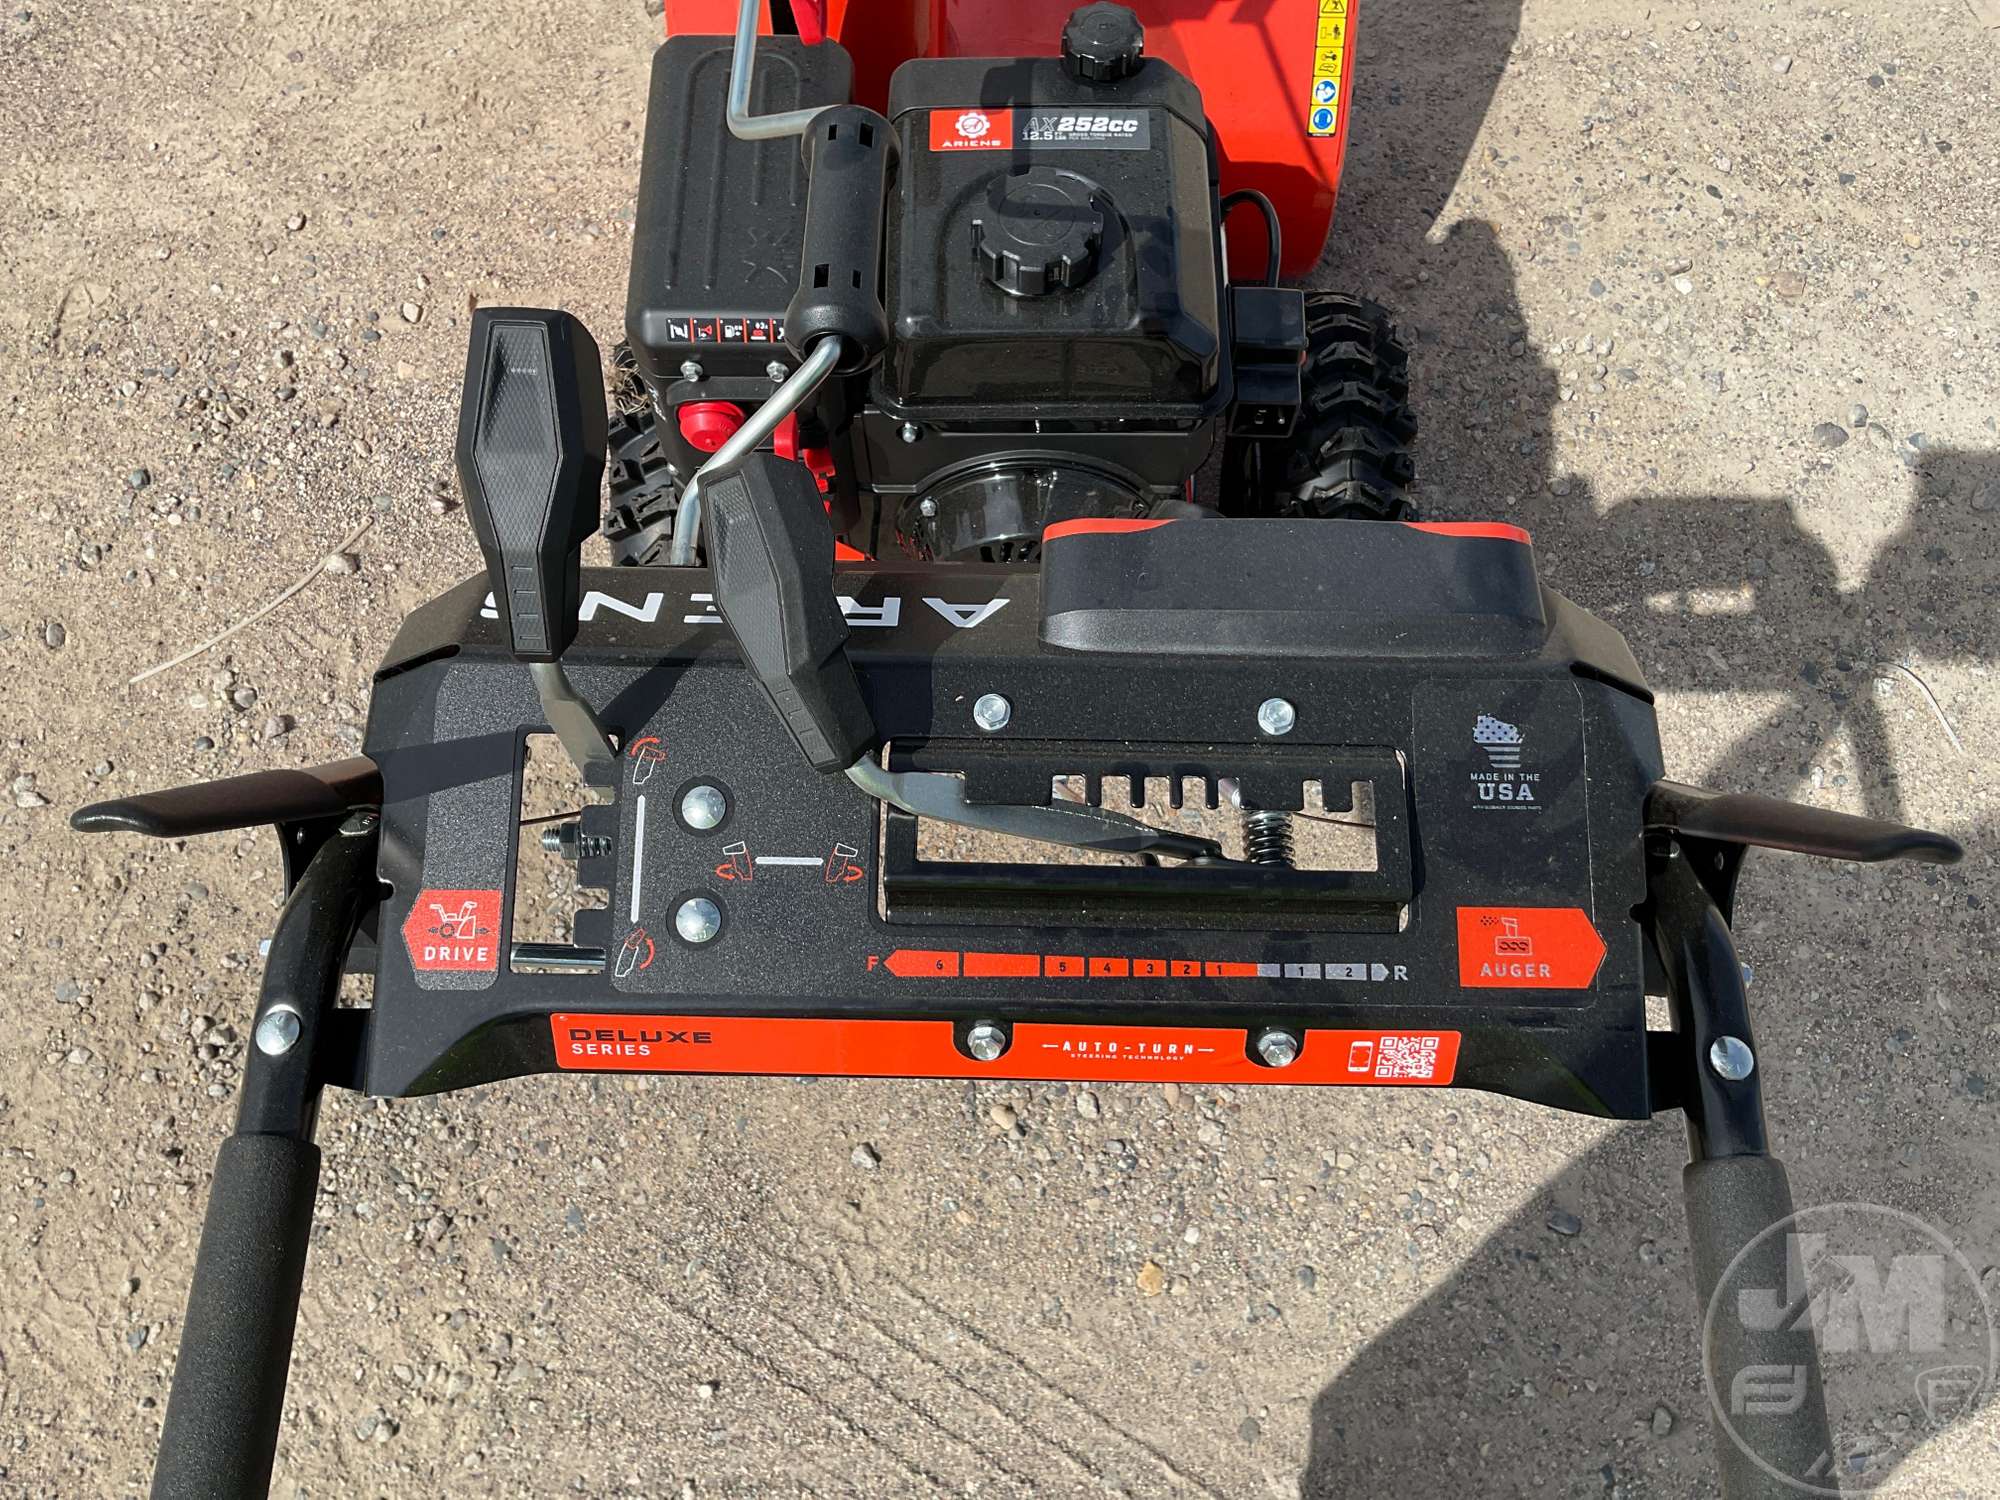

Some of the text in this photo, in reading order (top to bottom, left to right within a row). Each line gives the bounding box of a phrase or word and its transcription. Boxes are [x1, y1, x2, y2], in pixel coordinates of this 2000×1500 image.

[1022, 131, 1053, 141] 12.5
[942, 139, 1001, 147] ARIENS
[1470, 772, 1540, 781] MADE IN THE
[1478, 783, 1534, 801] USA
[424, 946, 489, 961] DRIVE
[866, 955, 879, 972] F
[936, 959, 944, 970] 6
[1059, 962, 1067, 972] 5
[1103, 963, 1111, 973] 4
[1146, 963, 1154, 974] 3
[1183, 964, 1191, 974] 2
[1345, 967, 1353, 977] 2
[1393, 965, 1409, 981] R
[1480, 962, 1551, 978] AUGER
[568, 1028, 712, 1044] DELUXE
[571, 1043, 650, 1056] SERIES
